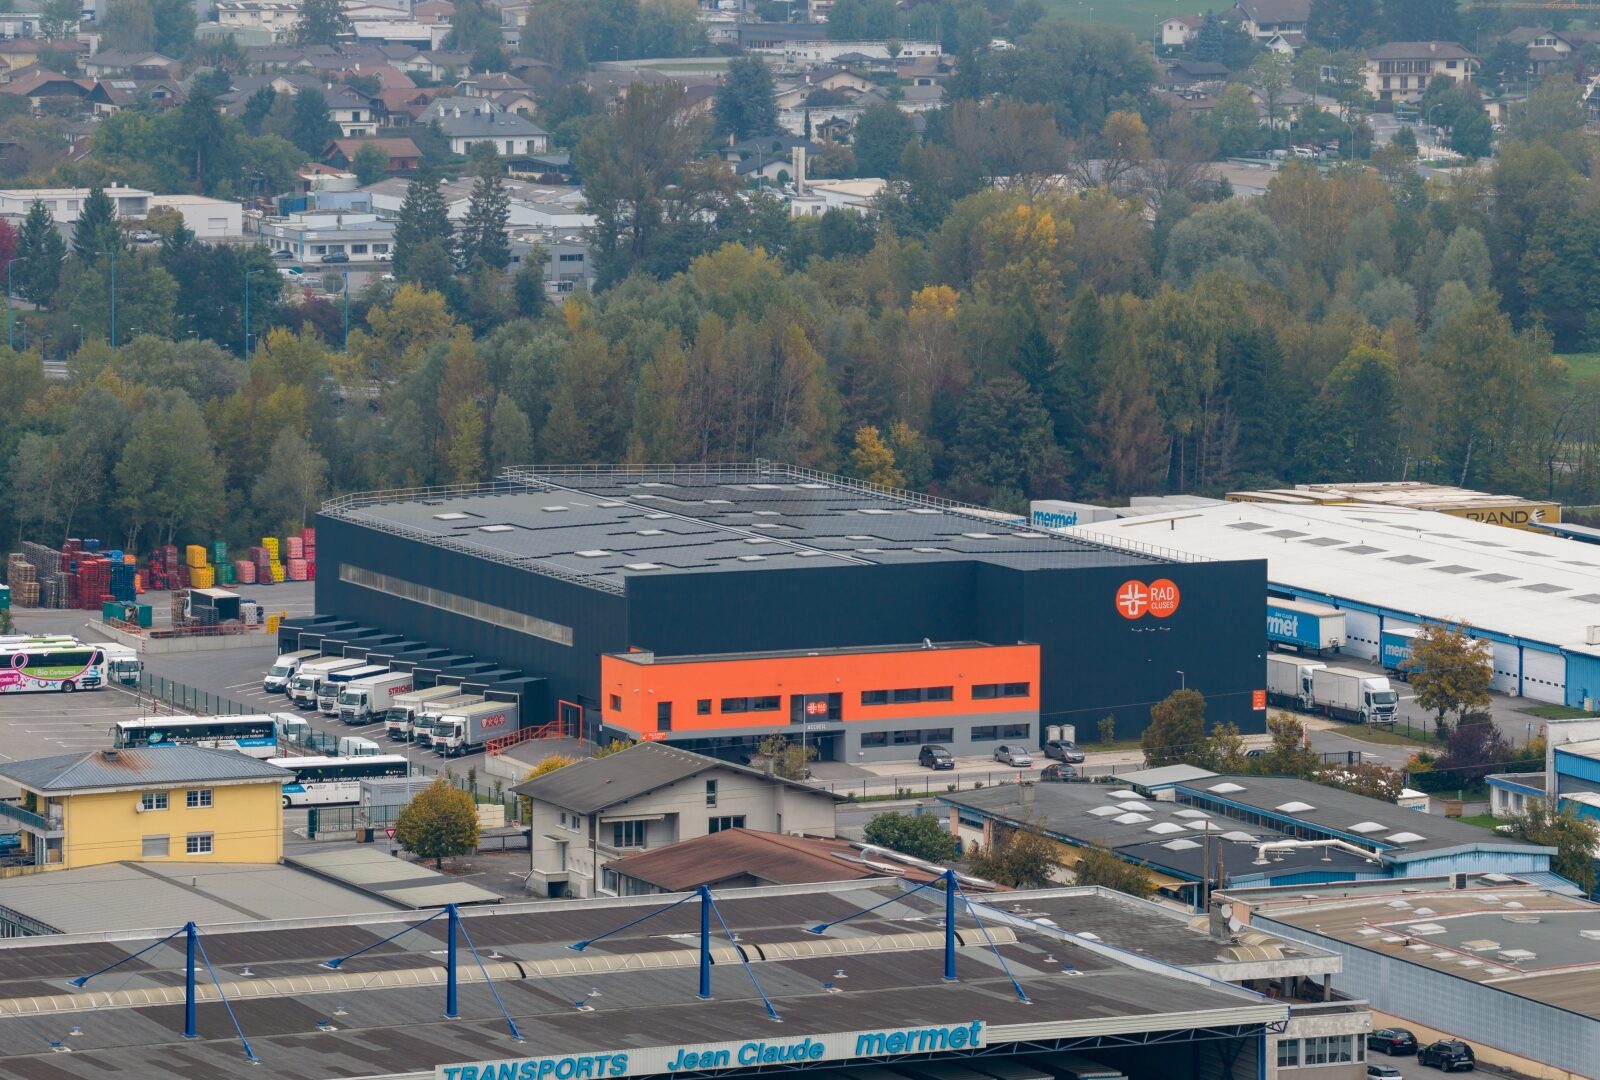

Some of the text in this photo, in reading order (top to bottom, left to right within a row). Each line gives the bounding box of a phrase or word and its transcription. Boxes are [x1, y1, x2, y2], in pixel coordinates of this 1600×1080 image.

[1033, 510, 1077, 528] mermet
[1150, 586, 1174, 601] RAD
[1151, 601, 1174, 609] CLUSES
[443, 1018, 982, 1080] TRANSPORTS Jean Claude mermet
